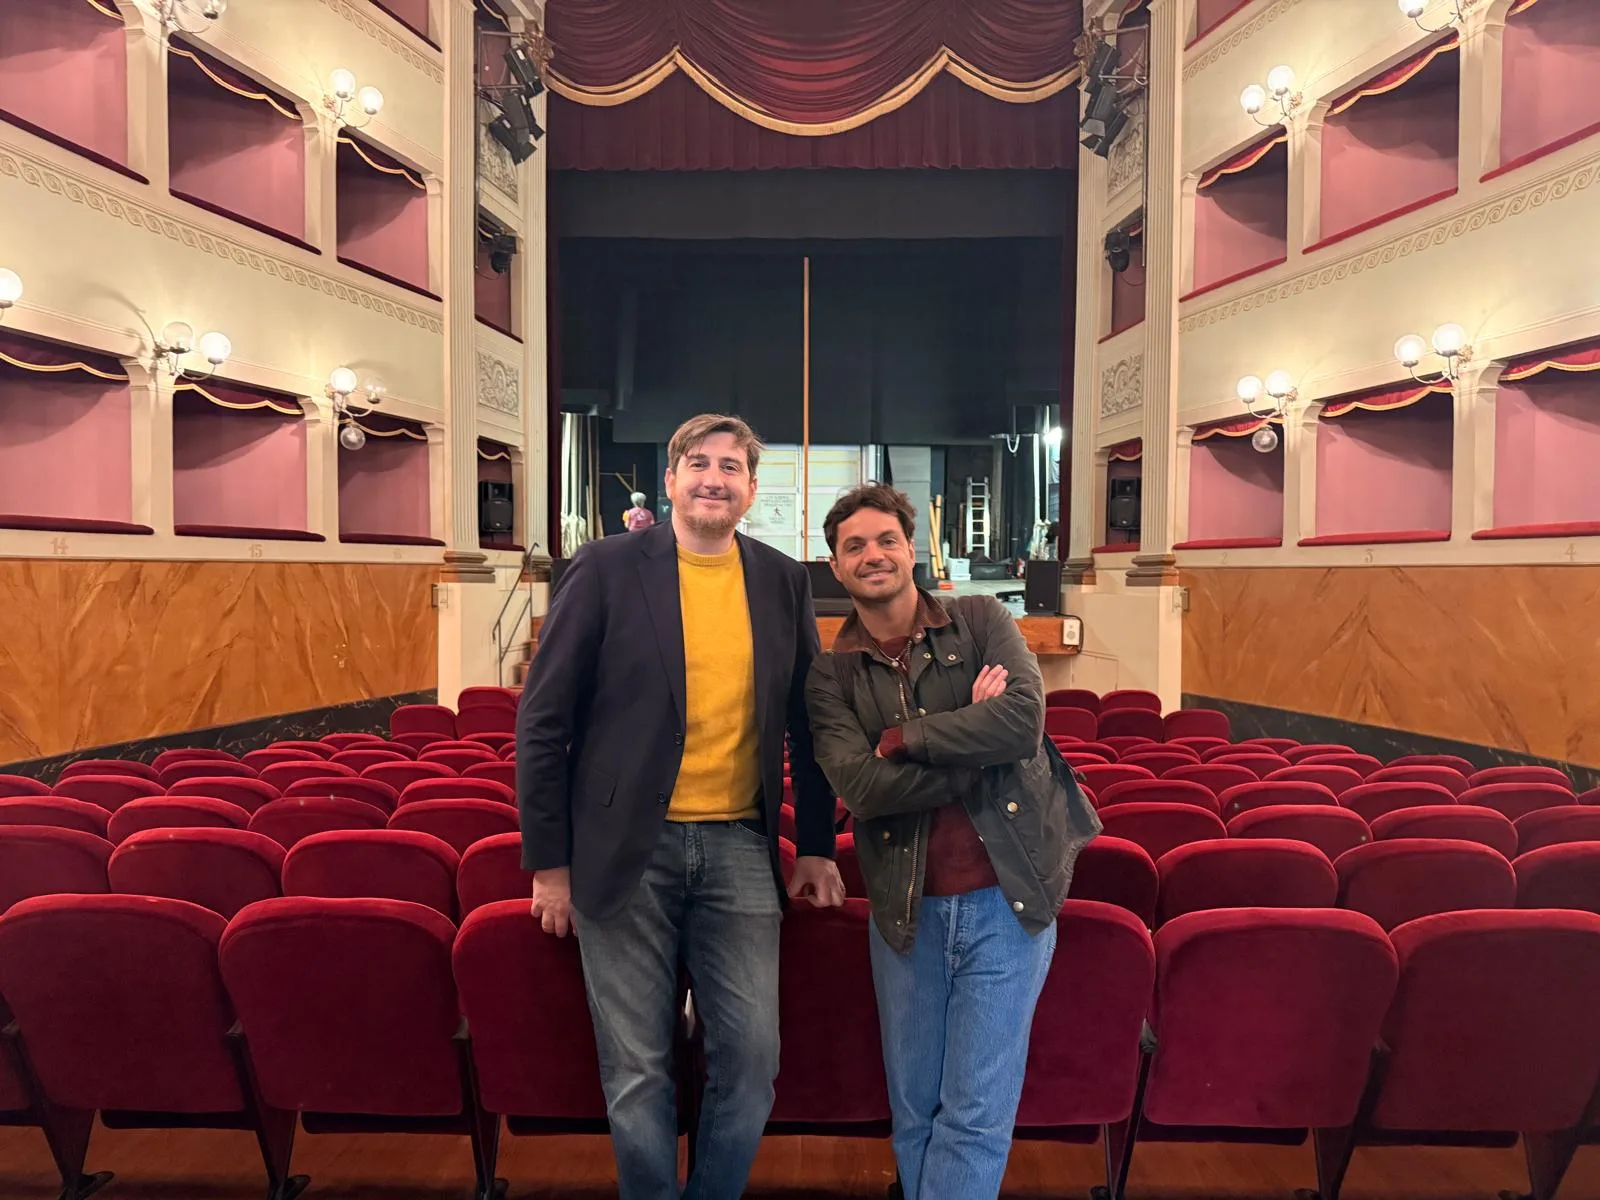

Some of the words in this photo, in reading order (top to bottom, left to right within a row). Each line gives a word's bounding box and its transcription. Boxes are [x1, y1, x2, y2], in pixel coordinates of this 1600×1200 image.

[50, 537, 69, 555] 14
[249, 543, 263, 558] 15
[1564, 542, 1578, 561] 4
